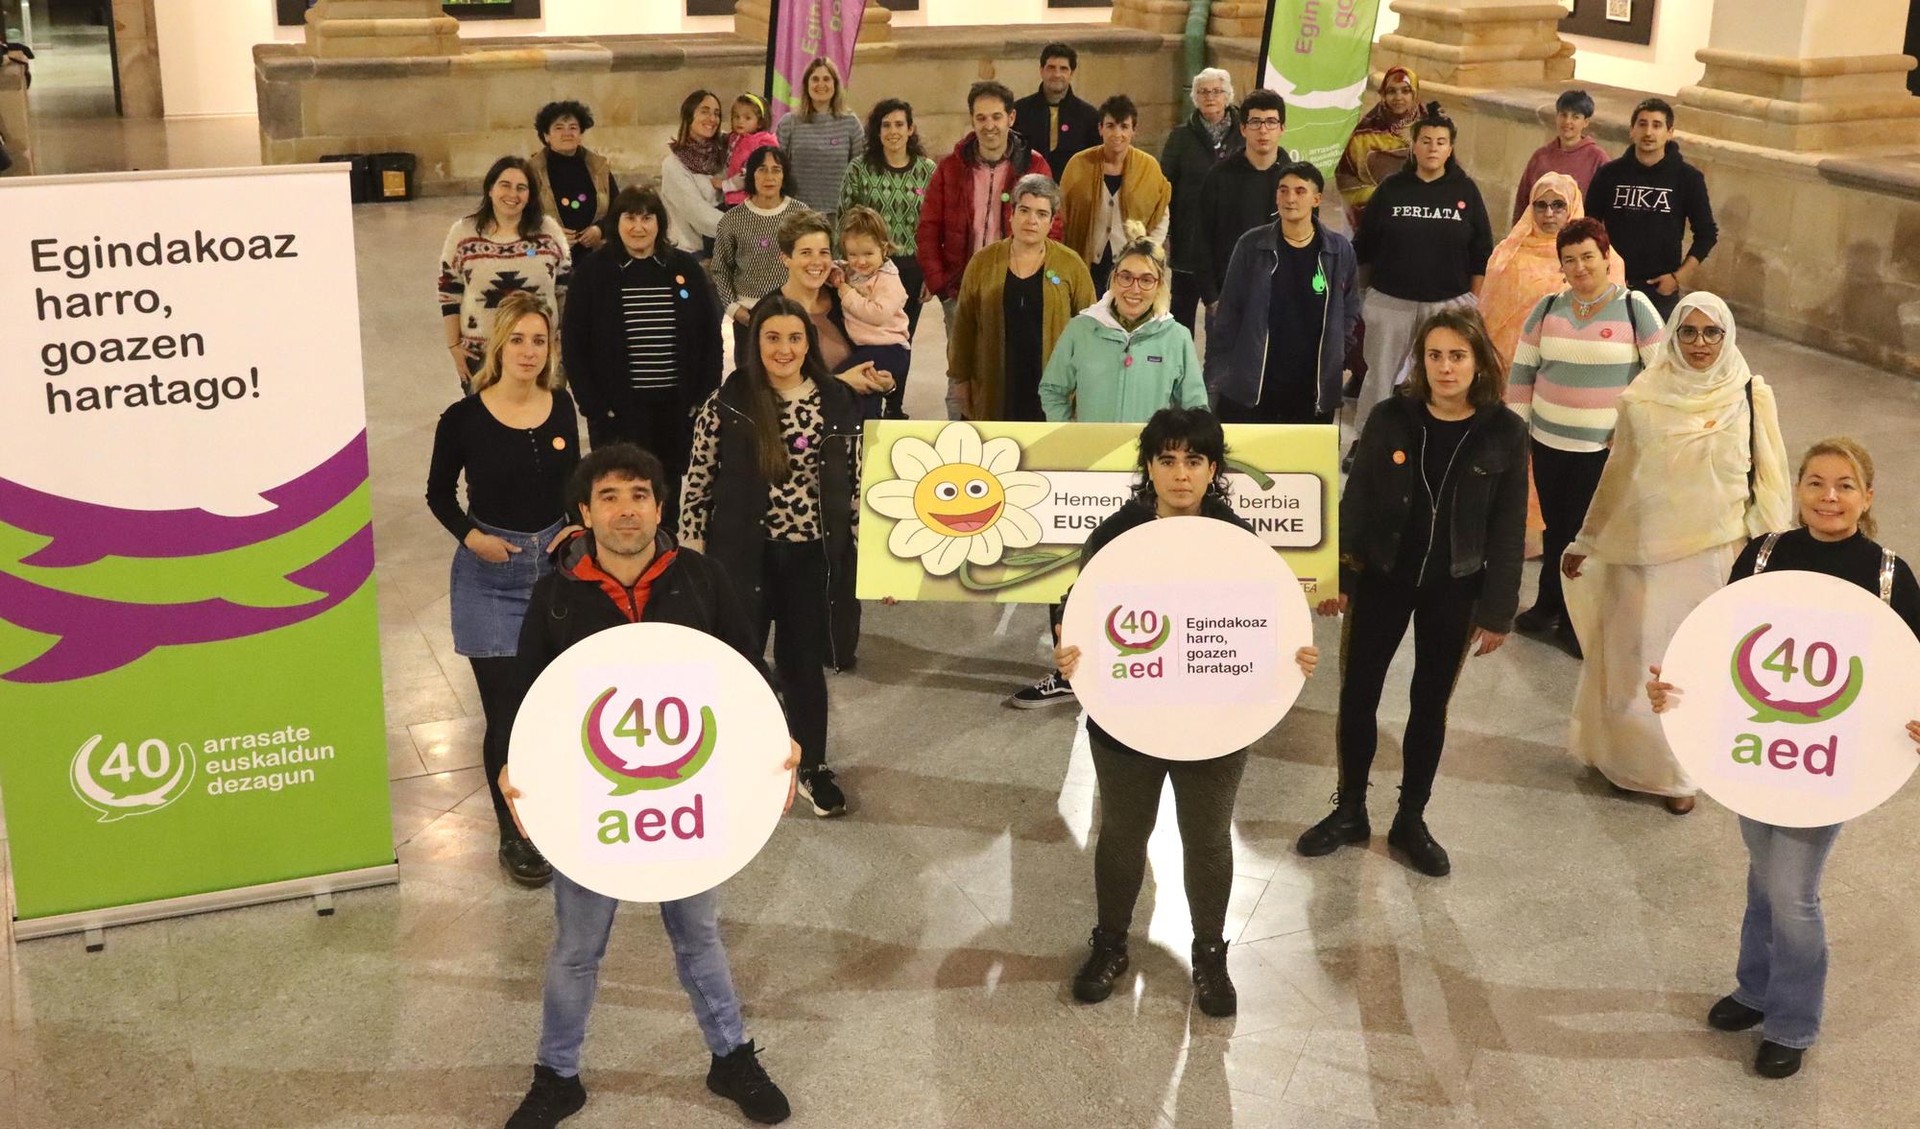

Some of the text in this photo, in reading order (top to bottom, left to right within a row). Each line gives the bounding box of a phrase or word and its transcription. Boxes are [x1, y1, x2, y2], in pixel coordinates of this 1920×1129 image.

[1391, 205, 1462, 221] PERLATA
[1613, 187, 1671, 210] HIKA
[30, 229, 299, 279] Egindakoaz
[35, 287, 172, 321] harro,
[41, 332, 205, 376] goazen
[46, 366, 260, 414] haratago!
[1054, 492, 1123, 506] Hemen
[1239, 495, 1300, 509] berbia
[1241, 517, 1304, 532] INKE
[1119, 610, 1157, 634] 40
[1186, 617, 1268, 631] Egindakoaz
[1186, 633, 1228, 645] harro,
[1111, 656, 1163, 679] aed
[1186, 649, 1237, 661] goazen
[1187, 661, 1253, 676] haratago!
[1761, 637, 1838, 688] 40
[613, 696, 690, 747] 40
[203, 725, 311, 754] arrasate
[100, 738, 170, 782] 40
[205, 745, 335, 774] euskaldun
[1731, 733, 1838, 777] aed
[207, 767, 315, 796] dezagun
[597, 793, 704, 845] aed
